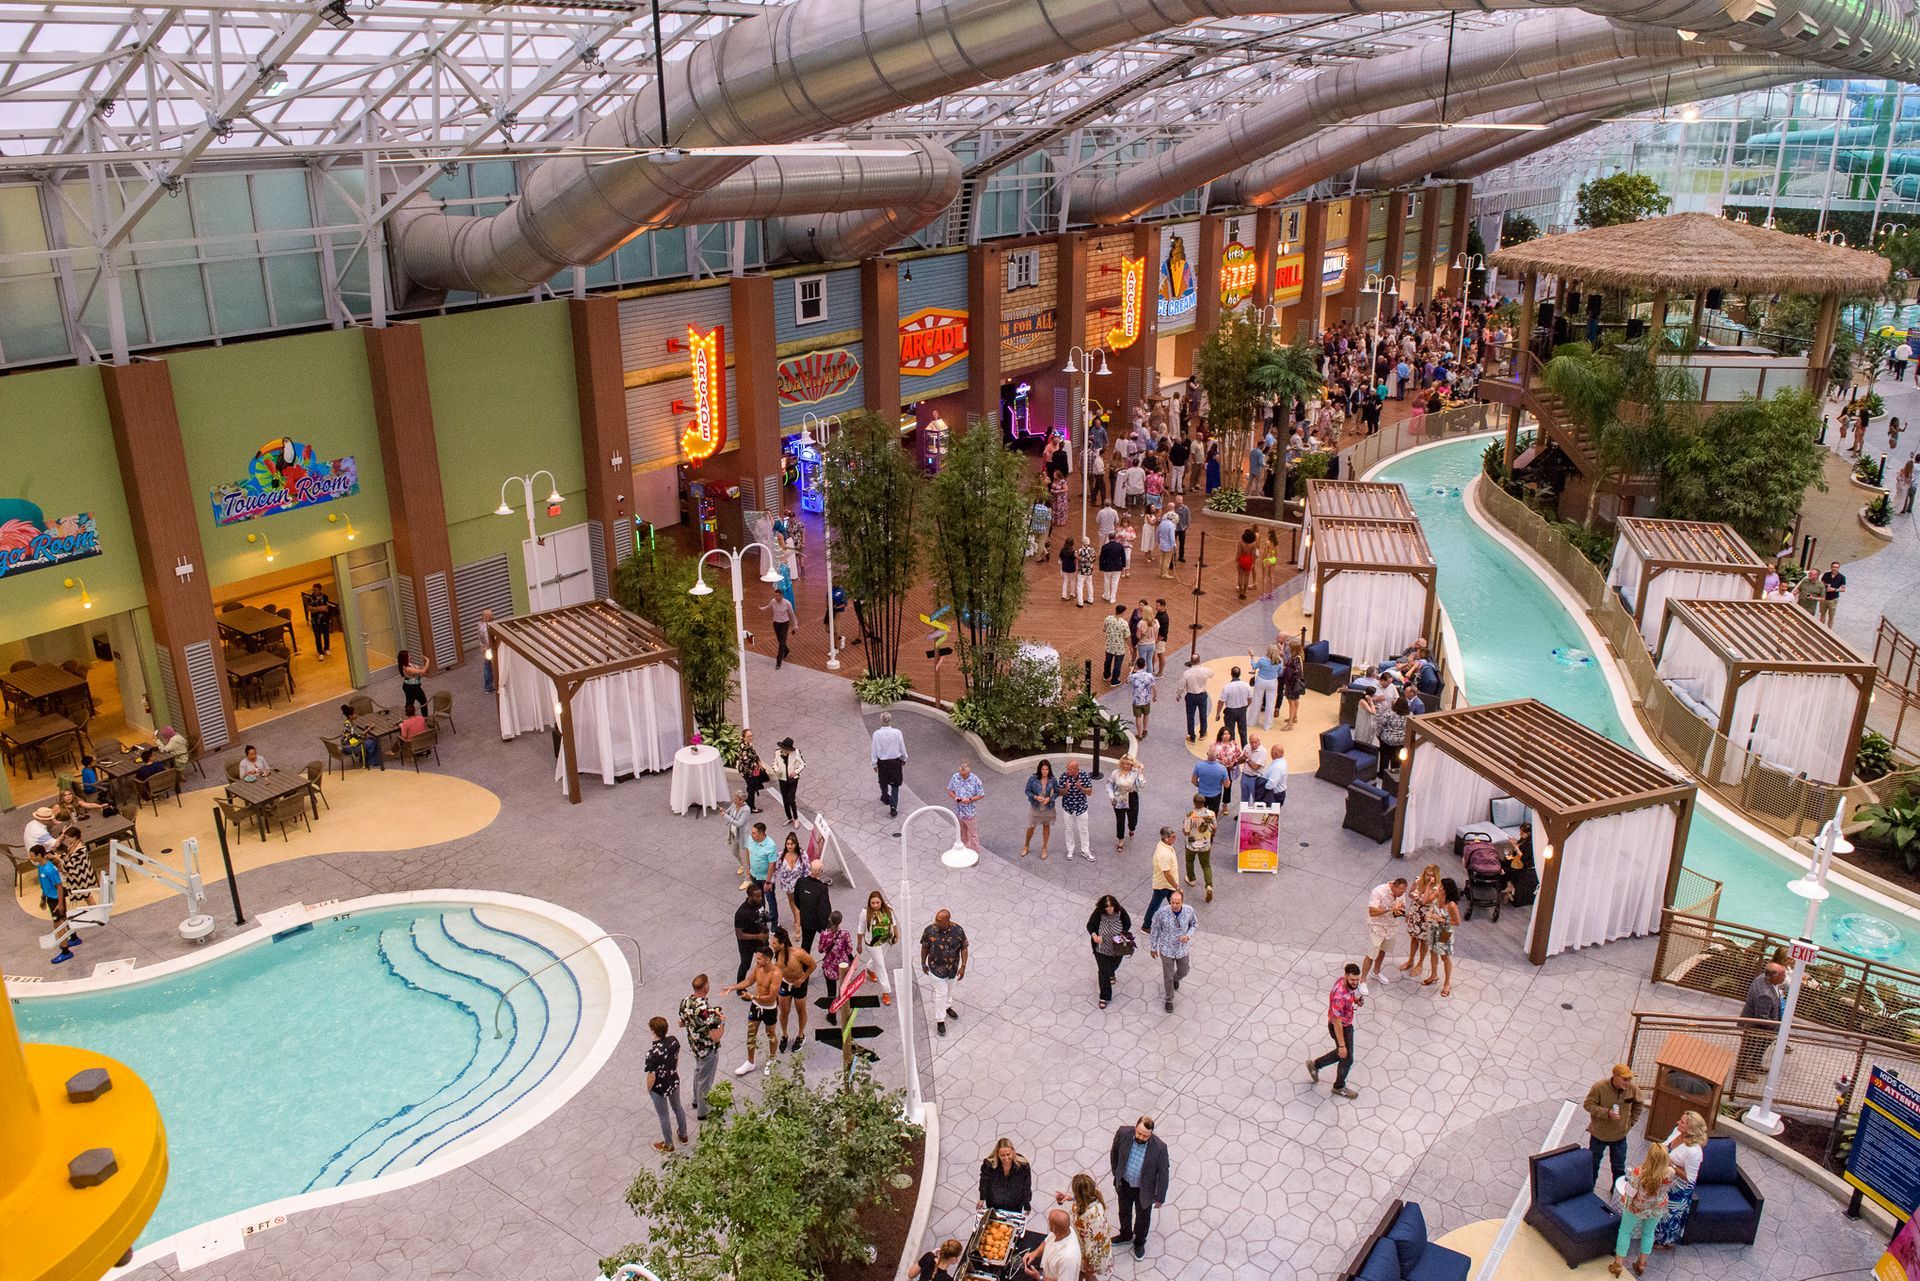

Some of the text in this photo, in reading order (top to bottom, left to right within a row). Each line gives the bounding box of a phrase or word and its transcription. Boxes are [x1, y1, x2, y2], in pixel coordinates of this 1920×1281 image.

[1125, 271, 1137, 336] ARCADE
[1167, 291, 1197, 316] CREAM
[1013, 319, 1032, 334] FOR
[1036, 311, 1053, 330] ALL
[901, 322, 964, 361] ARCADE
[697, 349, 710, 441] ARCADE
[223, 475, 349, 517] Toucan Room
[30, 531, 96, 561] Room
[1791, 945, 1814, 963] EXIT
[1879, 1071, 1898, 1087] KIDS
[1884, 1085, 1920, 1114] ATTENTI
[246, 1220, 270, 1234] 3 FT
